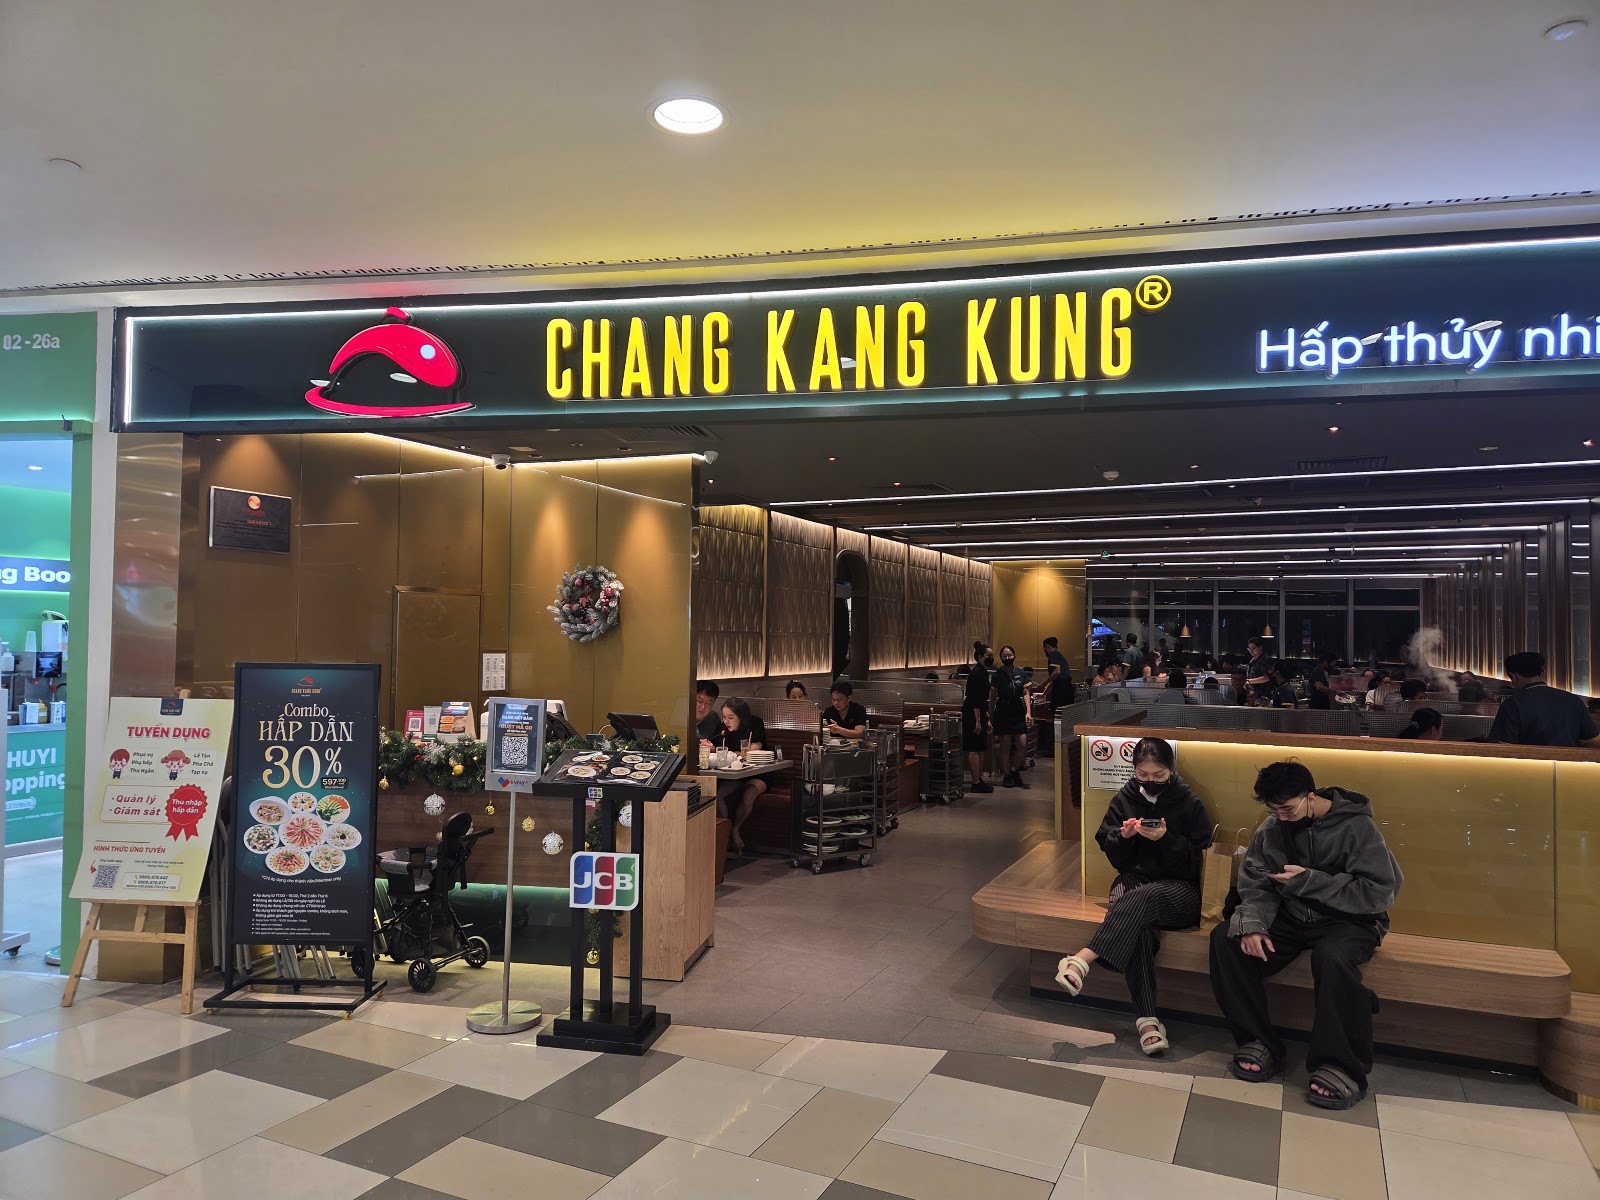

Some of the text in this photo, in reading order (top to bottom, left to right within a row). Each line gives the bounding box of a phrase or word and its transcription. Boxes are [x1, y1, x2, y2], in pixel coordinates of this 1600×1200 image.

[546, 311, 730, 400] CHANG
[767, 301, 926, 392] KANG
[1260, 320, 1363, 375] Hấp
[1384, 317, 1501, 369] thủy
[284, 702, 329, 717] Combo
[127, 722, 211, 742] TUYỂN DỤNG
[258, 713, 354, 742] HẤP DẪN
[7, 747, 57, 768] HUYI
[262, 745, 342, 789] 30%
[116, 794, 157, 805] Quản lý
[113, 806, 161, 816] Giám sát
[93, 844, 111, 852] HÌNH
[573, 871, 633, 891] JCB
